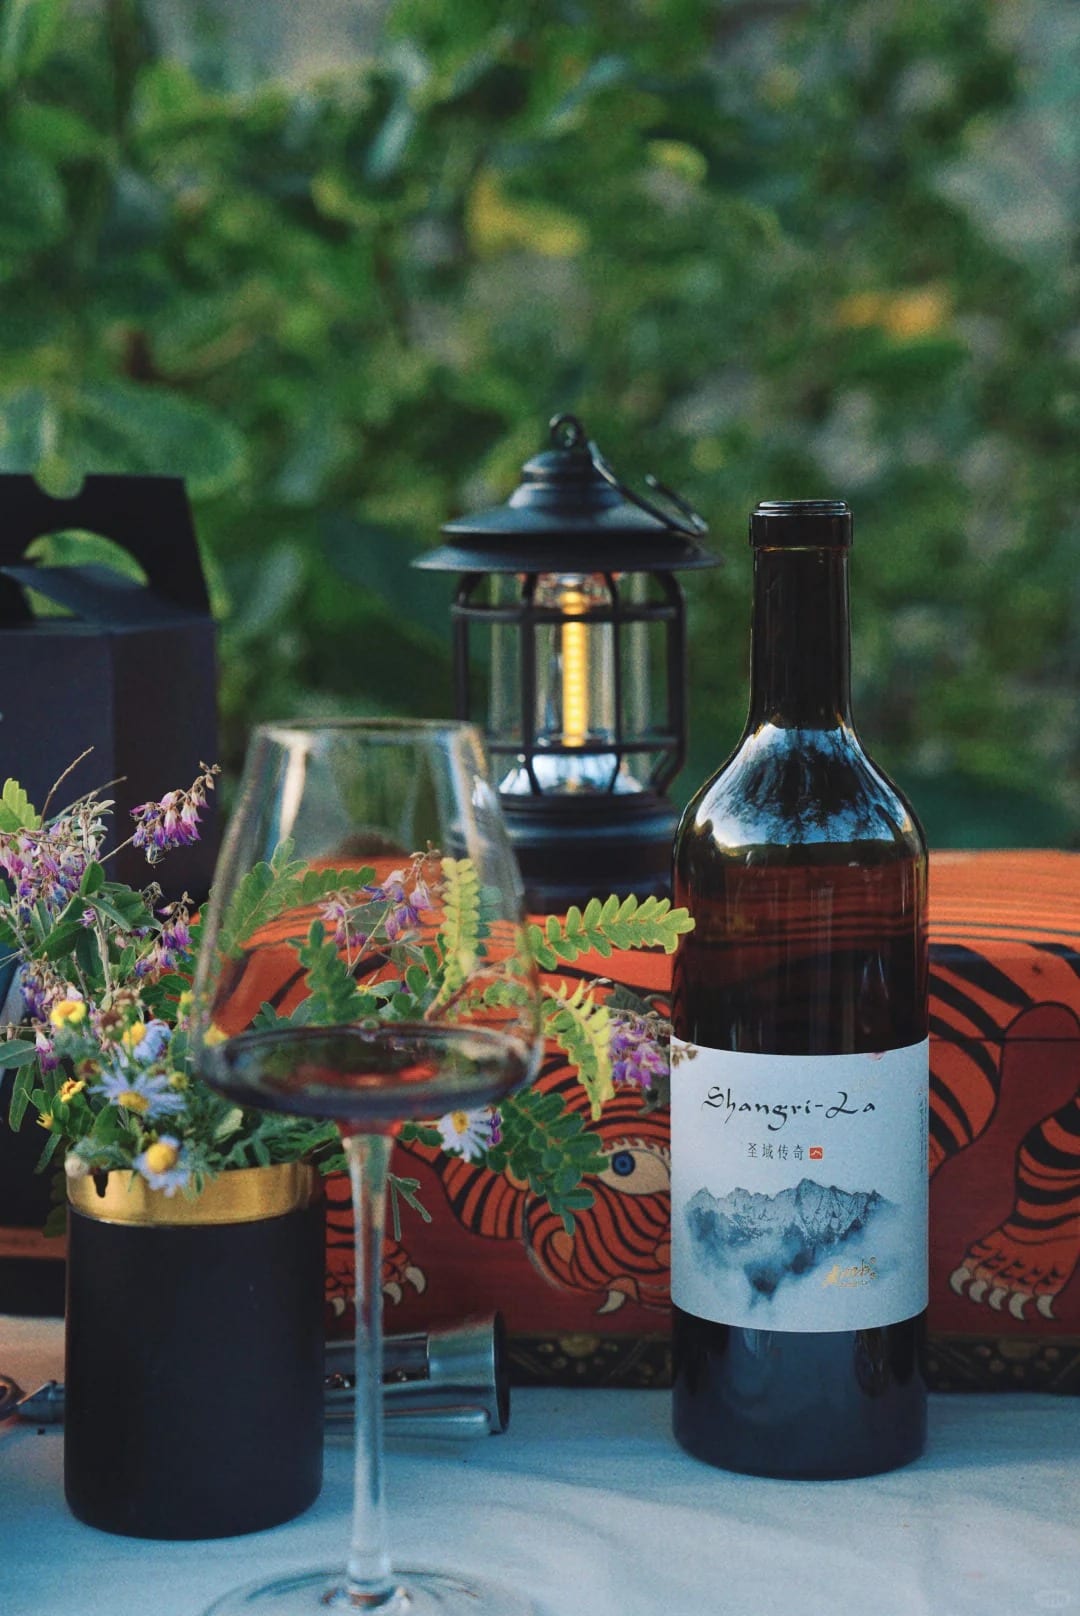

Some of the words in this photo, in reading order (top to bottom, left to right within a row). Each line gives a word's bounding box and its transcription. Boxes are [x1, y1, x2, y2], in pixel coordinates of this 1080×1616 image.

[701, 1085, 876, 1131] Shangri-La
[747, 1142, 804, 1161] 圣域传奇
